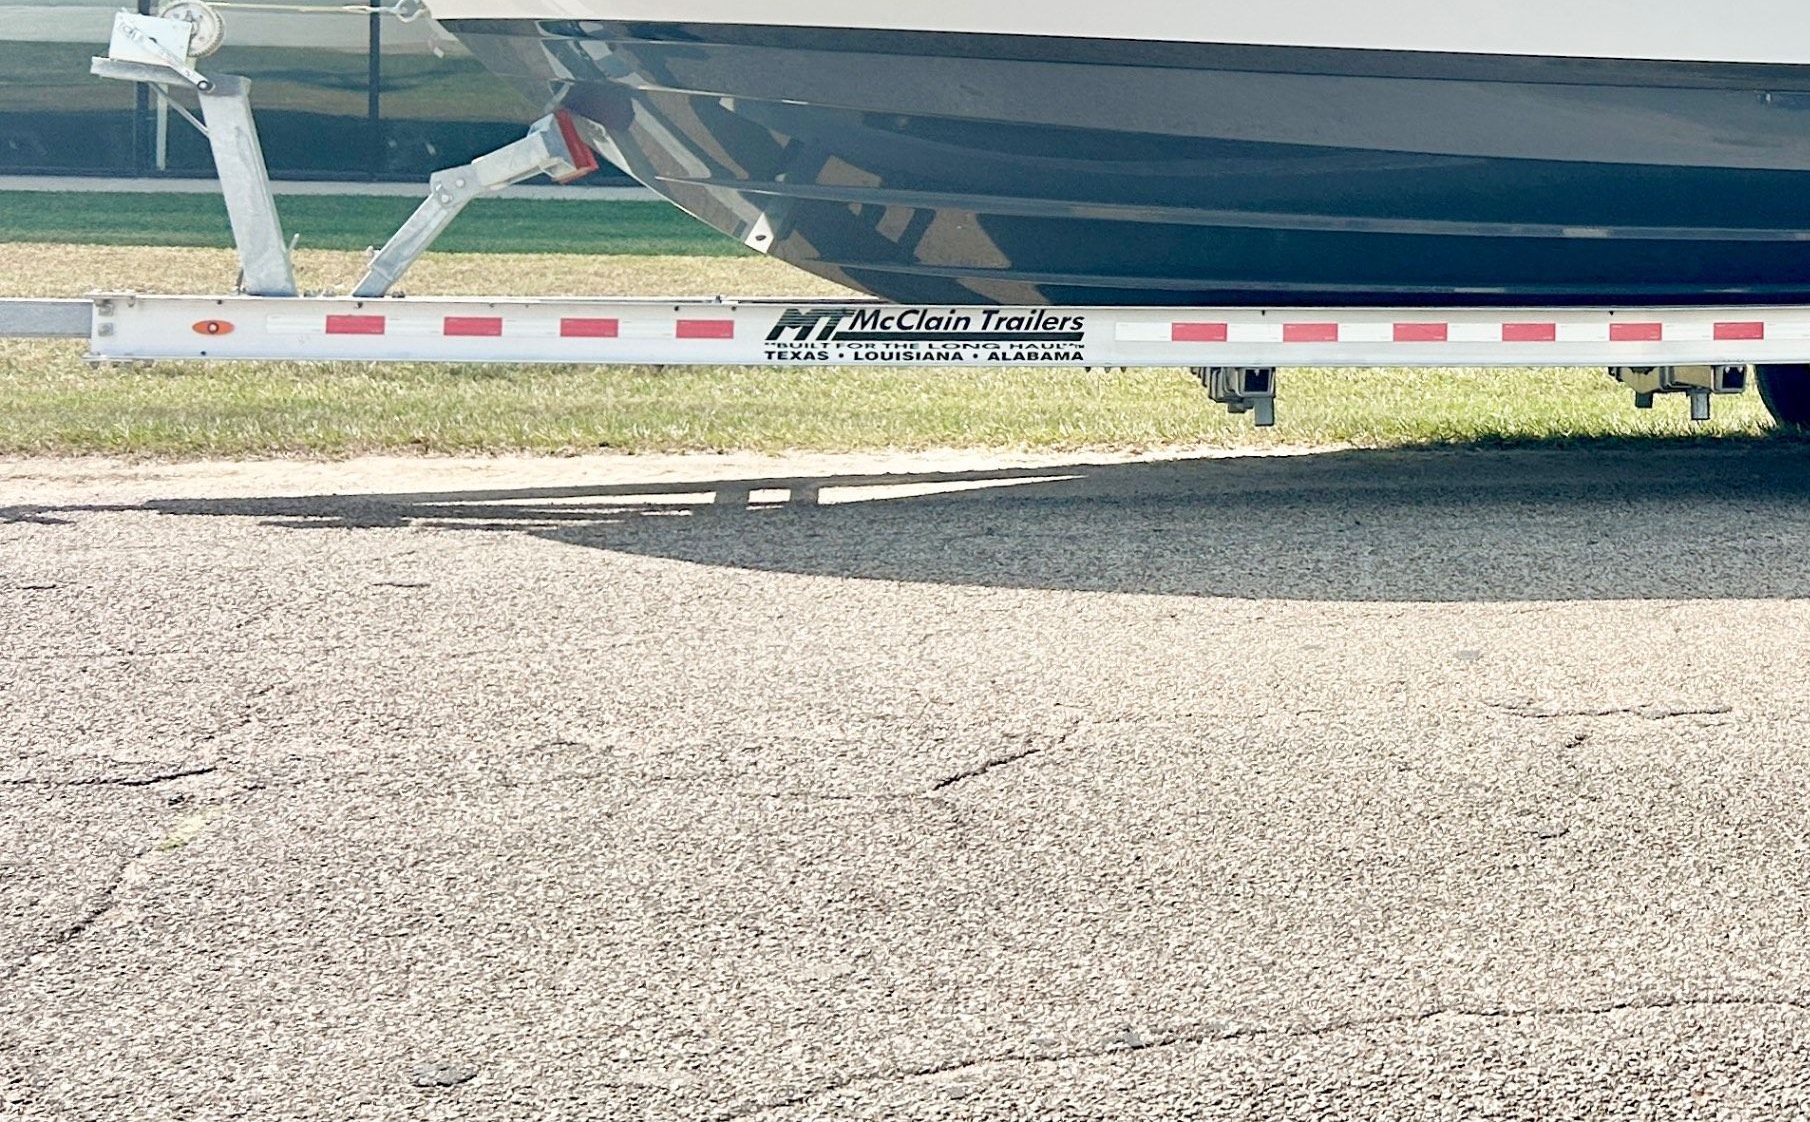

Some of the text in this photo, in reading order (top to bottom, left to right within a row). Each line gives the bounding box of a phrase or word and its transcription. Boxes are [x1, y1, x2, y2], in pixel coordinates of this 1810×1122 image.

[765, 308, 1085, 341] MT McClain Trailers
[836, 342, 876, 350] FOR
[882, 342, 920, 350] THE
[928, 342, 1001, 350] LONG
[764, 351, 1084, 361] TEXAS LOUISIANA ALABAMA
